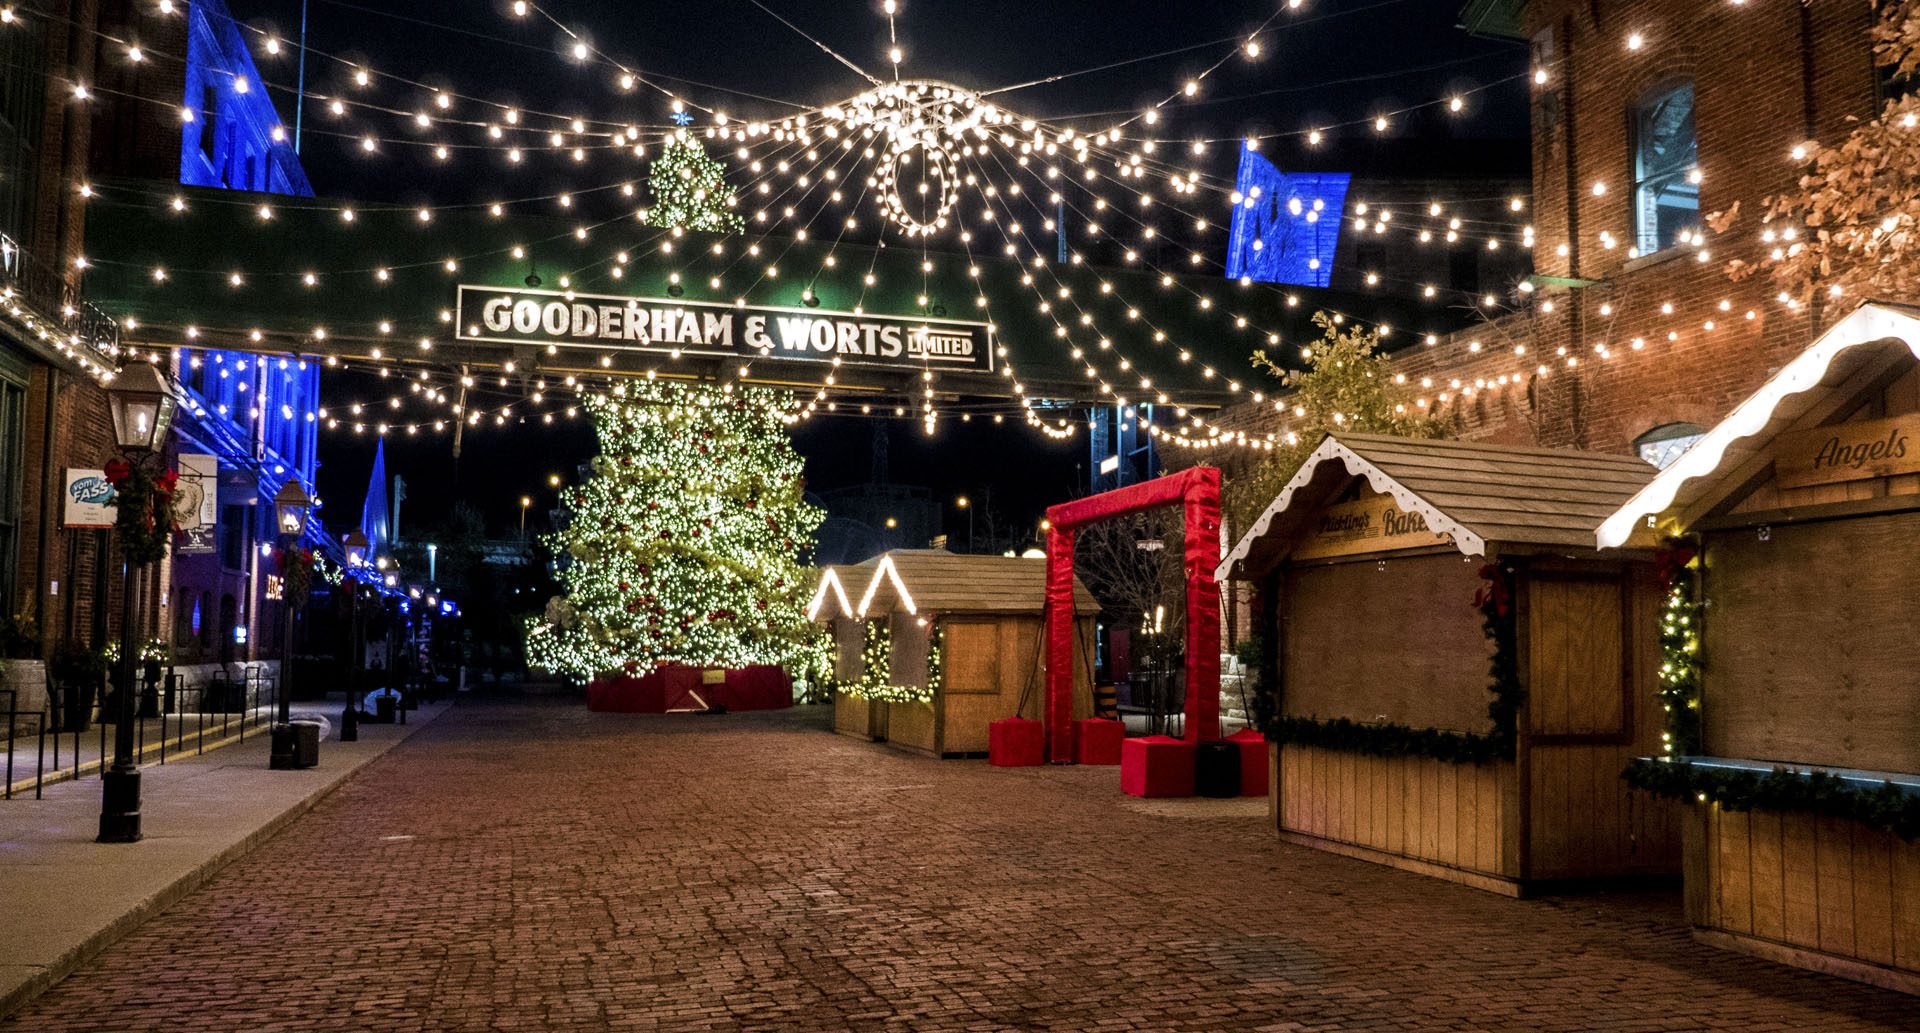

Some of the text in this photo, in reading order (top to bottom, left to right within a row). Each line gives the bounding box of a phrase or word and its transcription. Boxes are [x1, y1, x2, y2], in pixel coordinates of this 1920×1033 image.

[483, 298, 973, 358] GOODERHAM & WORTS LIMITED
[1814, 428, 1909, 470] Angels
[73, 479, 93, 491] vom
[73, 482, 109, 503] FASS
[1382, 508, 1443, 539] Bake
